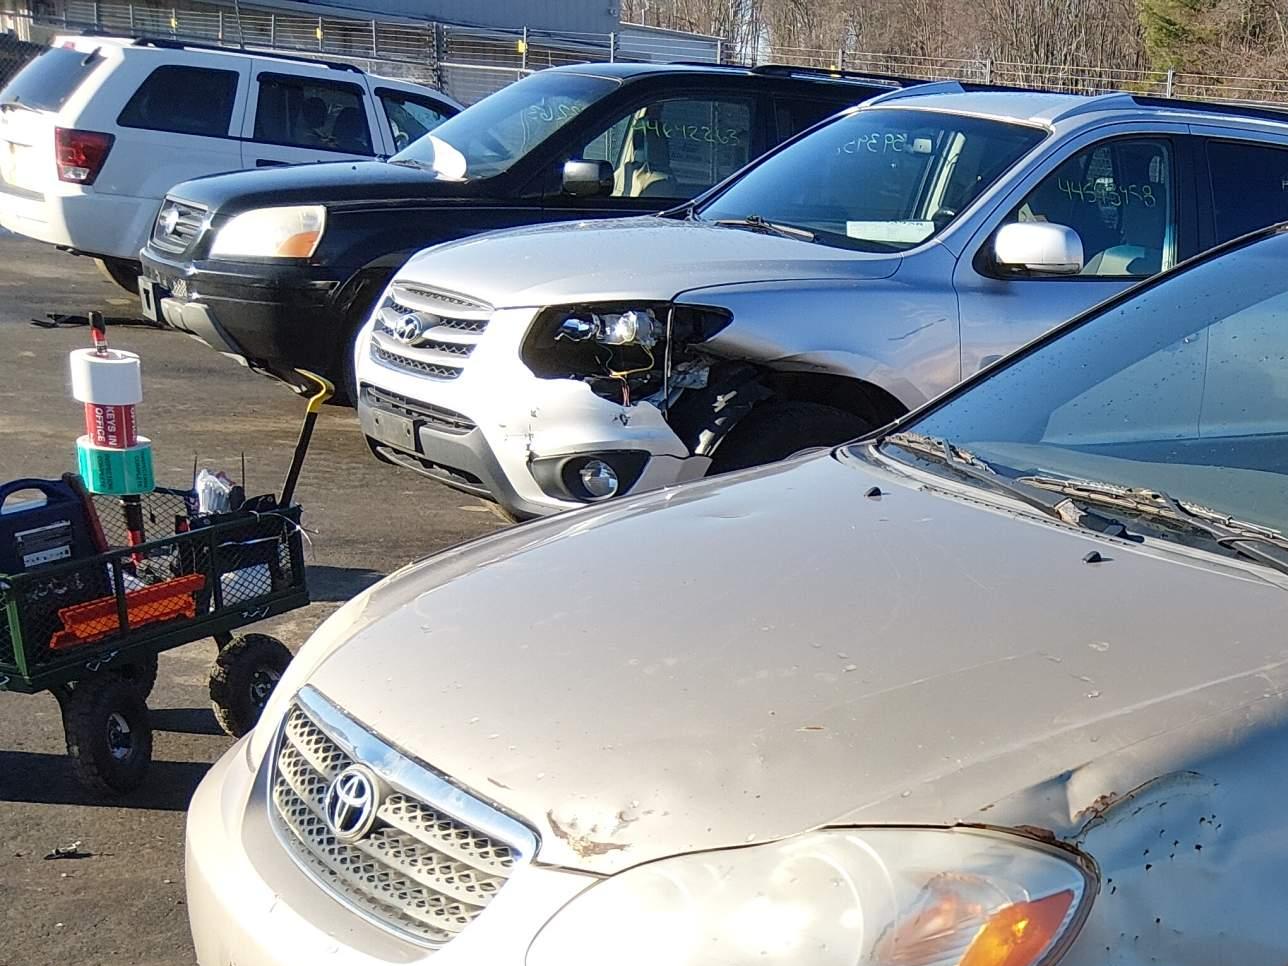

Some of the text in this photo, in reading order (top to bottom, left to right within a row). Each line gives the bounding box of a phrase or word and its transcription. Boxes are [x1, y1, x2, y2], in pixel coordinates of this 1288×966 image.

[95, 406, 106, 442] OFFICE
[105, 405, 118, 447] KEYS IN
